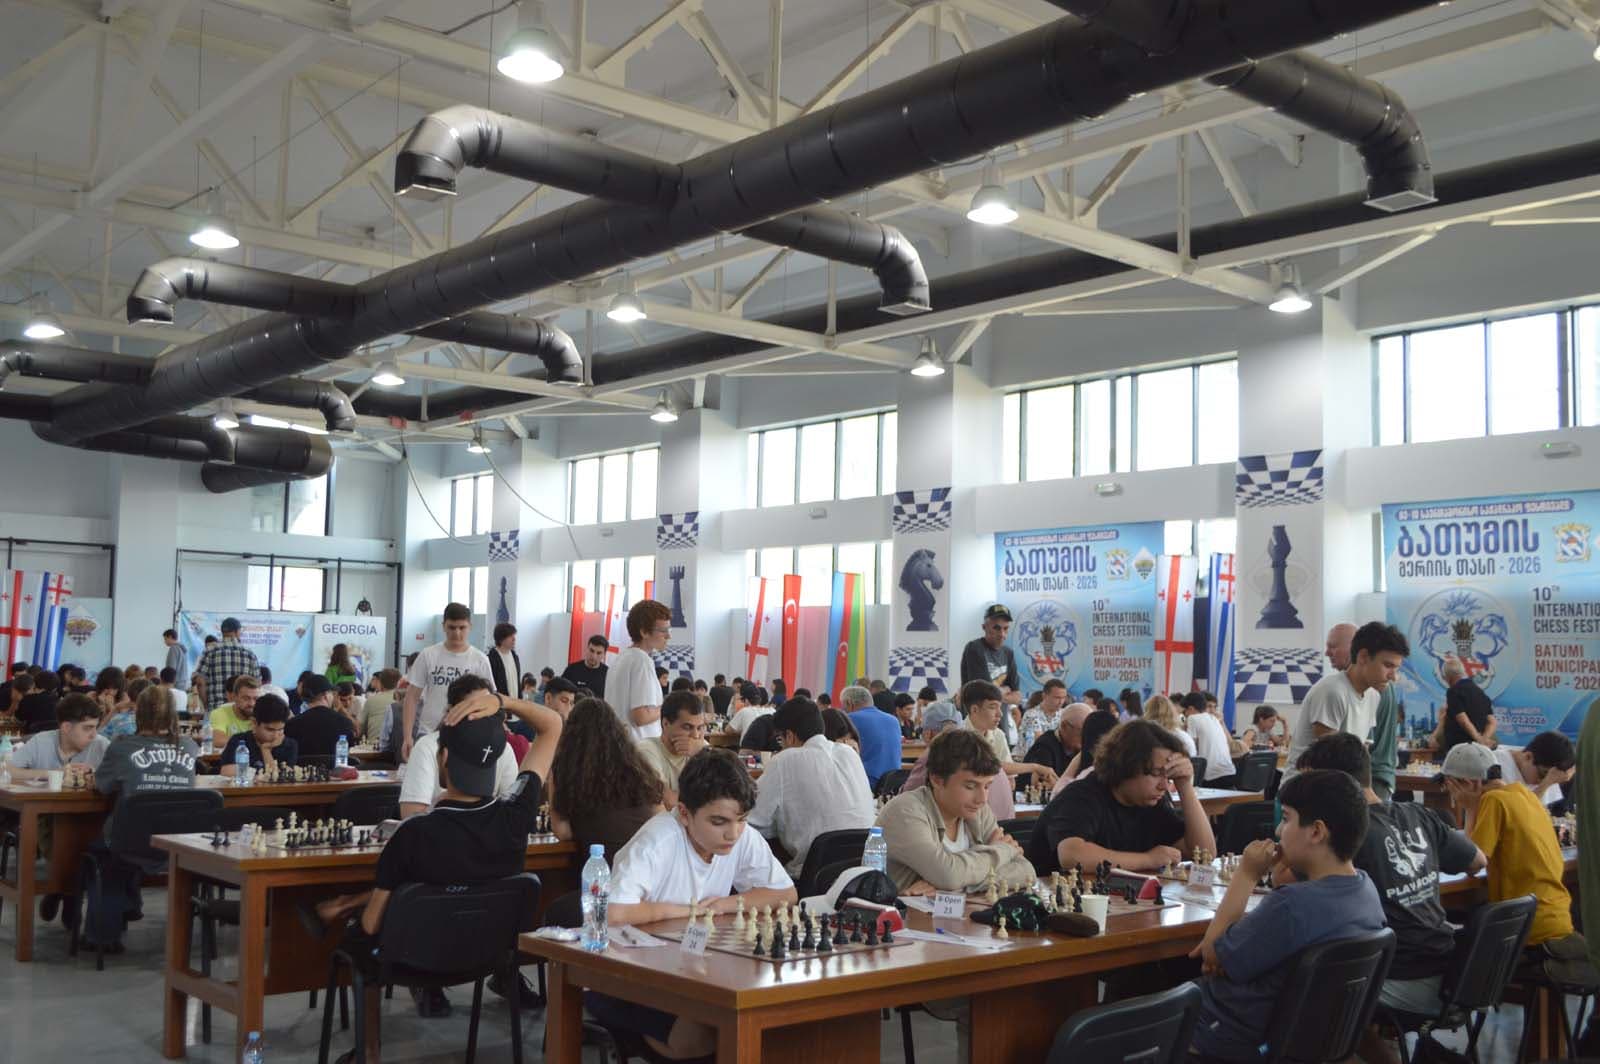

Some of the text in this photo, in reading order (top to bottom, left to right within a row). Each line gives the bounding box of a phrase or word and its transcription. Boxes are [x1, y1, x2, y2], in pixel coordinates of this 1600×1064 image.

[1398, 518, 1539, 558] ბათუმის
[1005, 545, 1096, 576] ბათუმის
[1456, 558, 1495, 576] თასი
[1509, 556, 1542, 574] 2026
[1043, 576, 1069, 591] თასი
[1092, 611, 1152, 624] INTERNATIONAL
[322, 622, 378, 636] GEORGIA
[1092, 624, 1152, 637] CHESS FESTIVAL
[1534, 619, 1569, 633] CHESS
[1093, 645, 1125, 656] BATUMI
[1535, 644, 1584, 657] BATUMI
[1094, 657, 1152, 669] MUNICIPALITY
[1094, 670, 1110, 681] CUP
[1536, 676, 1561, 689] CUP
[131, 747, 195, 770] Tropics
